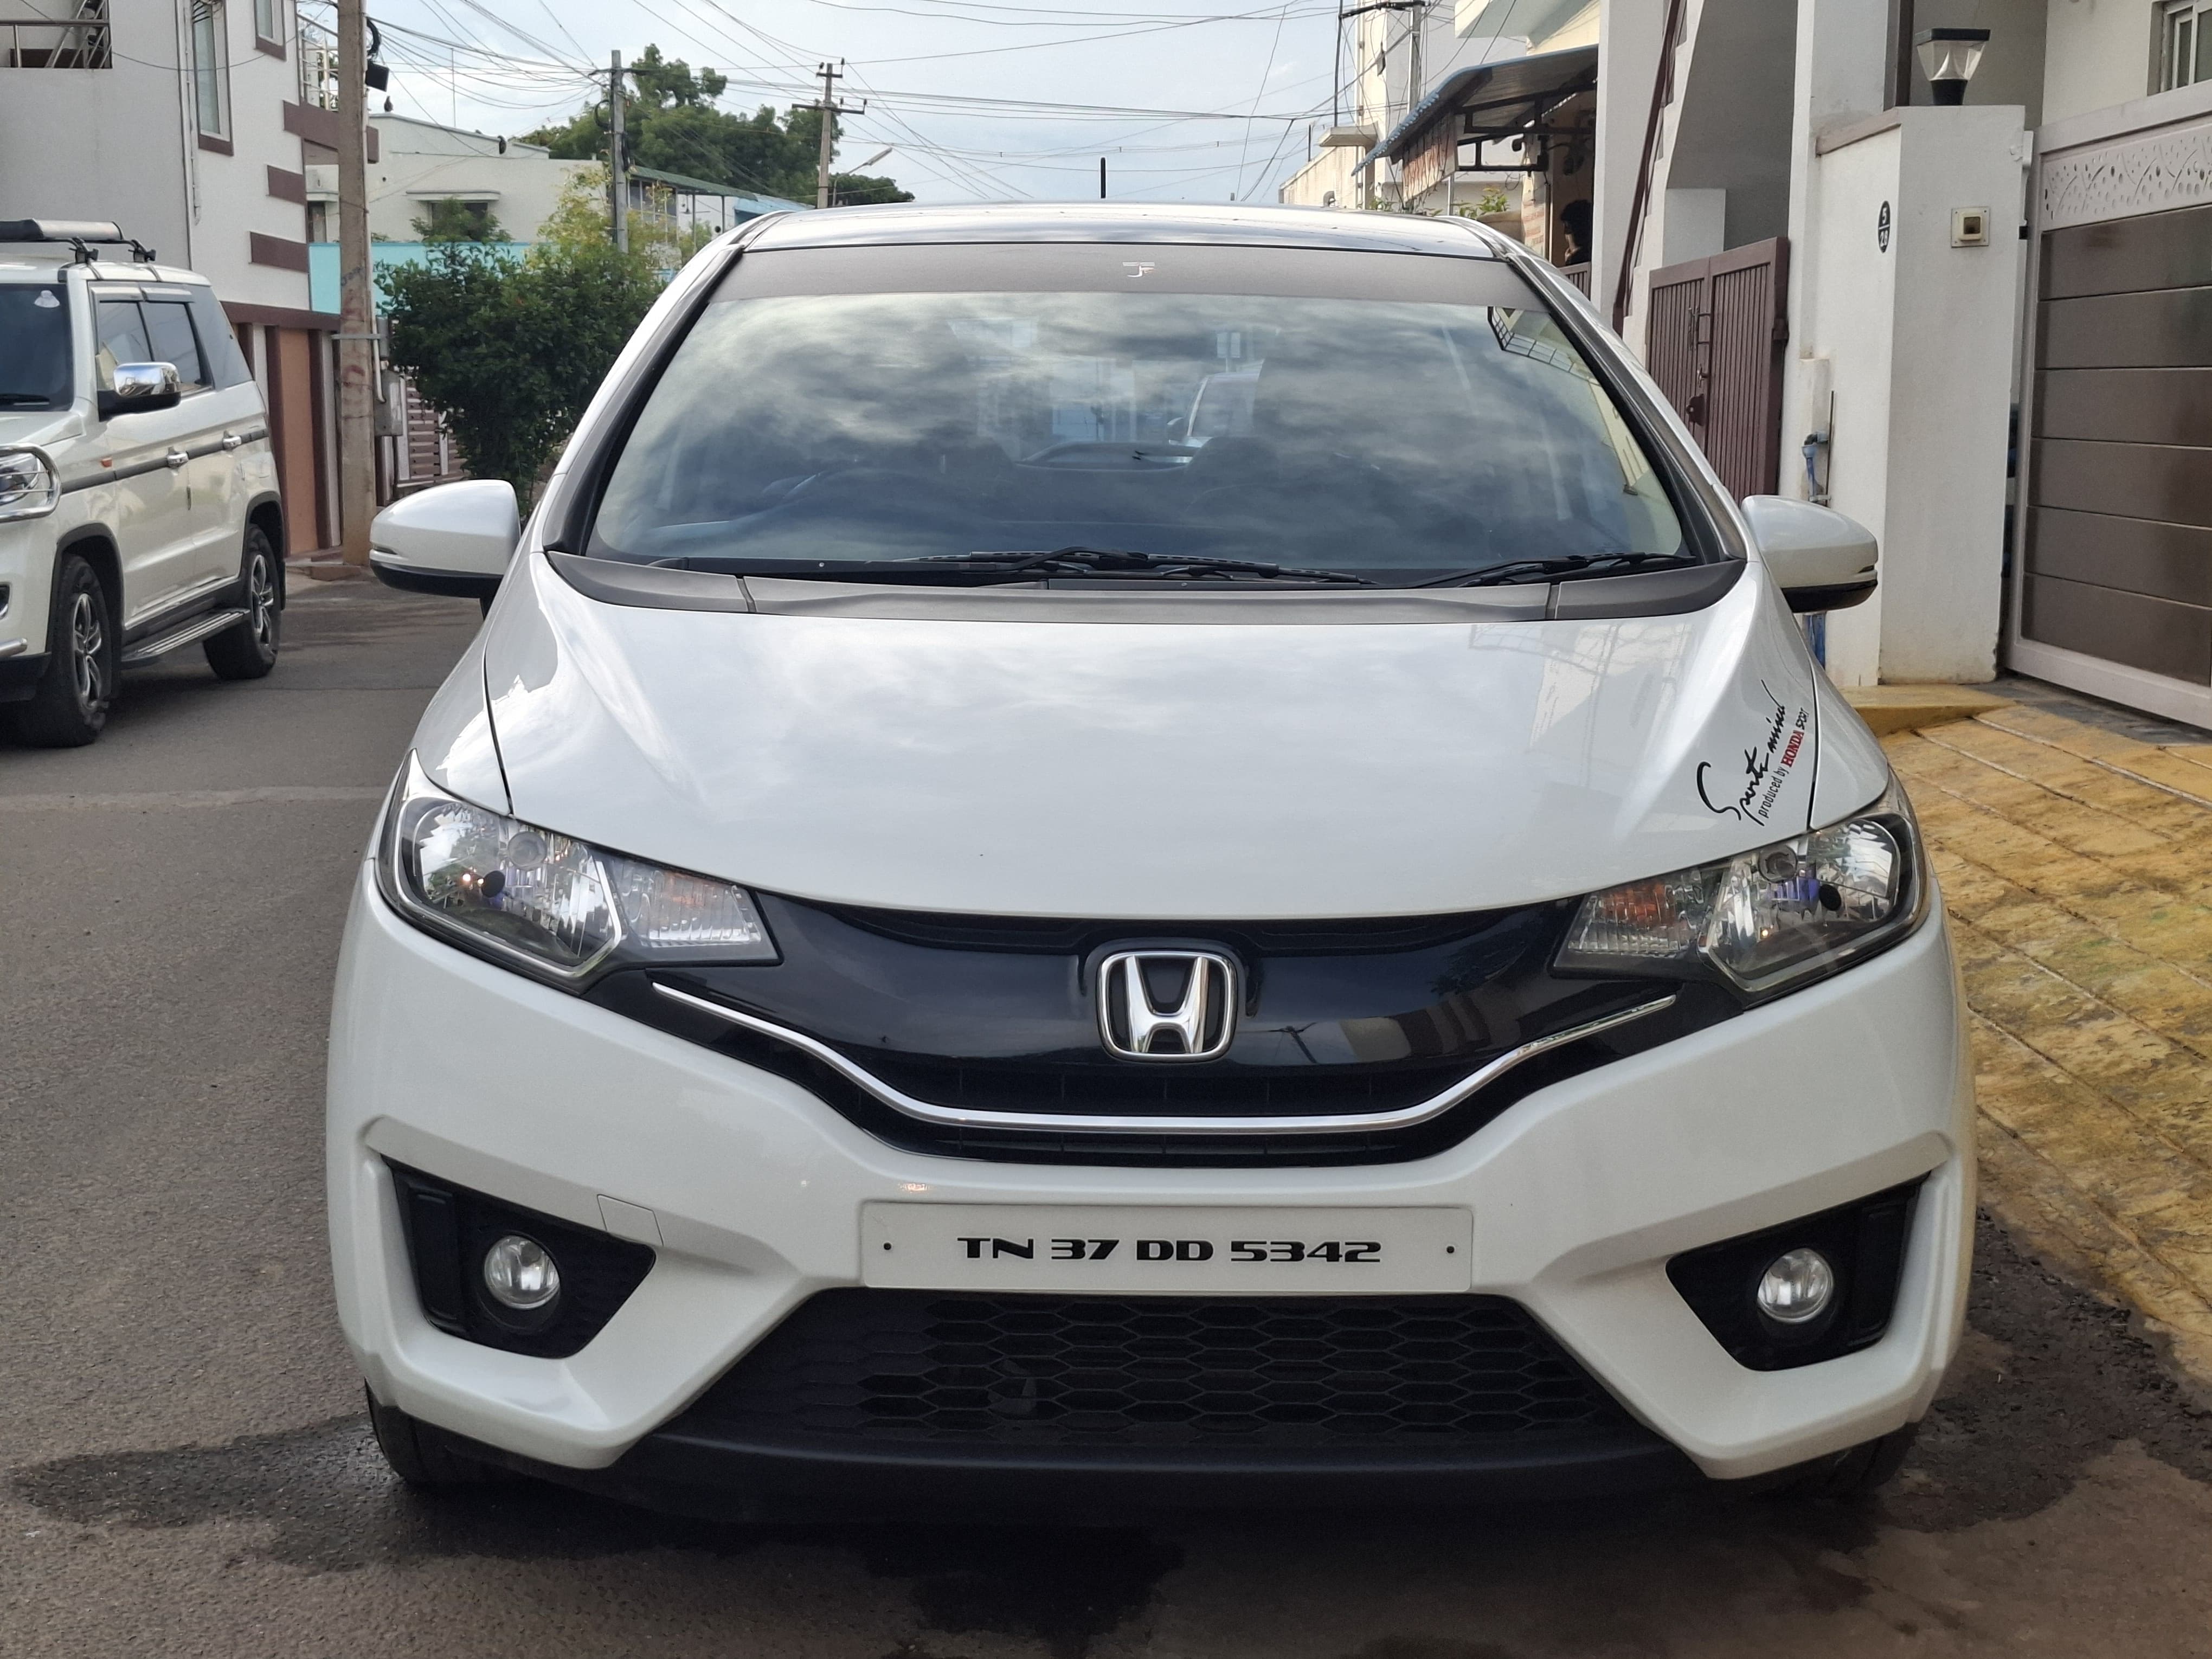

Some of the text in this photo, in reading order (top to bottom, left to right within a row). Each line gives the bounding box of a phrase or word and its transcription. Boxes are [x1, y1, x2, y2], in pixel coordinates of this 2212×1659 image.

[1882, 207, 1887, 224] 5
[1780, 730, 1805, 768] HONDA
[1774, 766, 1790, 777] by
[1758, 775, 1783, 819] produced
[957, 1237, 1381, 1263] TN 37 DD 5342
